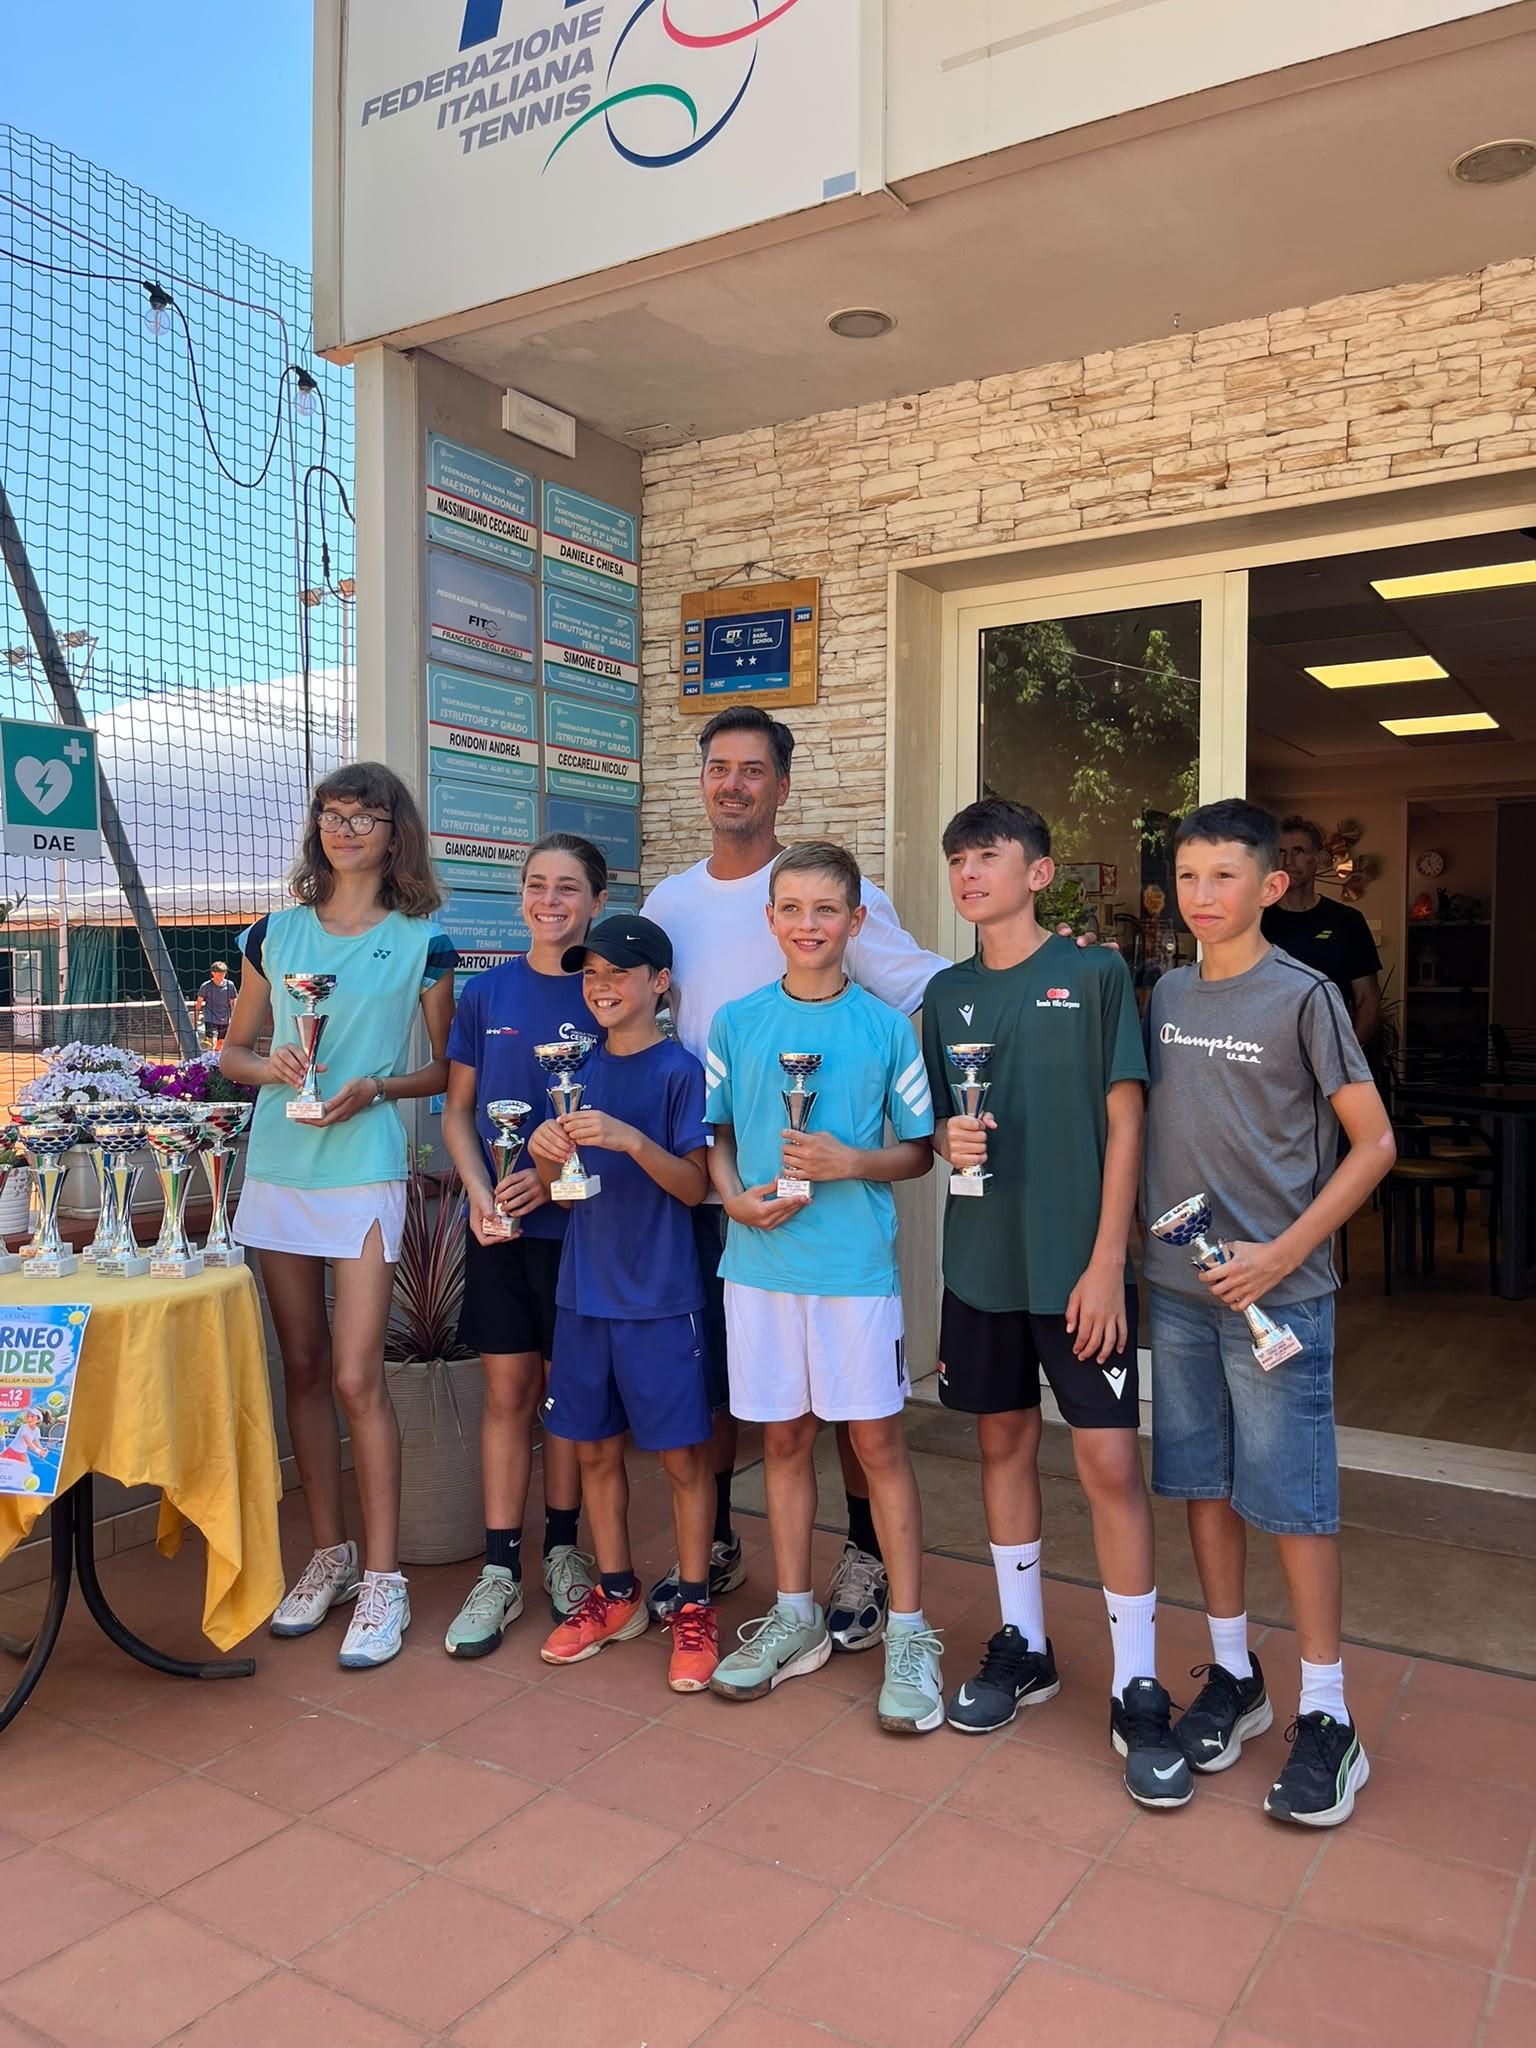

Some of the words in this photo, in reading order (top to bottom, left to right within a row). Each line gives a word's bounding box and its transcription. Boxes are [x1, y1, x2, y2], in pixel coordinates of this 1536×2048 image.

[361, 6, 604, 127] FEDERAZIONE
[436, 47, 594, 131] ITALIANA
[458, 84, 591, 155] TENNIS
[441, 476, 480, 498] MAESTRO
[482, 492, 526, 516] NAZIONALE
[437, 497, 488, 528] MASSIMILIANO
[489, 516, 529, 542] CECCARELLI
[554, 516, 591, 534] ISTRUTTORE
[606, 535, 628, 549] LIVELLO
[571, 531, 592, 544] BEACH
[593, 539, 613, 551] TENNIS
[560, 544, 594, 566] DANIELE
[596, 557, 624, 576] CHIESA
[468, 614, 487, 628] FIT
[726, 629, 743, 638] FIT
[442, 630, 480, 647] FRANCESCO
[482, 642, 500, 652] DEGLI
[500, 647, 522, 658] ANGELI
[552, 620, 592, 639] ISTRUTTORE
[609, 638, 631, 650] GRADO
[581, 640, 605, 654] TENNIS
[563, 651, 596, 669] SIMONE
[597, 662, 622, 676] D'ELIA
[440, 708, 488, 726] ISTRUTTORE
[500, 722, 528, 734] GRADO
[449, 733, 487, 751] RONDONI
[489, 740, 520, 758] ANDREA
[555, 732, 598, 748] ISTRUTTORE
[607, 743, 631, 754] GRADO
[558, 753, 600, 771] CECCARELLI
[602, 762, 629, 776] NICOLO'
[441, 819, 490, 833] ISTRUTTORE
[502, 826, 529, 838] GRADO
[34, 834, 75, 851] DAE
[445, 841, 496, 859] GIANGRANDI
[498, 848, 526, 862] MARCO
[444, 926, 488, 936] STRUTTORE
[490, 928, 497, 936] di
[476, 940, 502, 948] TENNIS
[570, 1034, 597, 1044] CESENA
[1160, 1022, 1264, 1057] Champion
